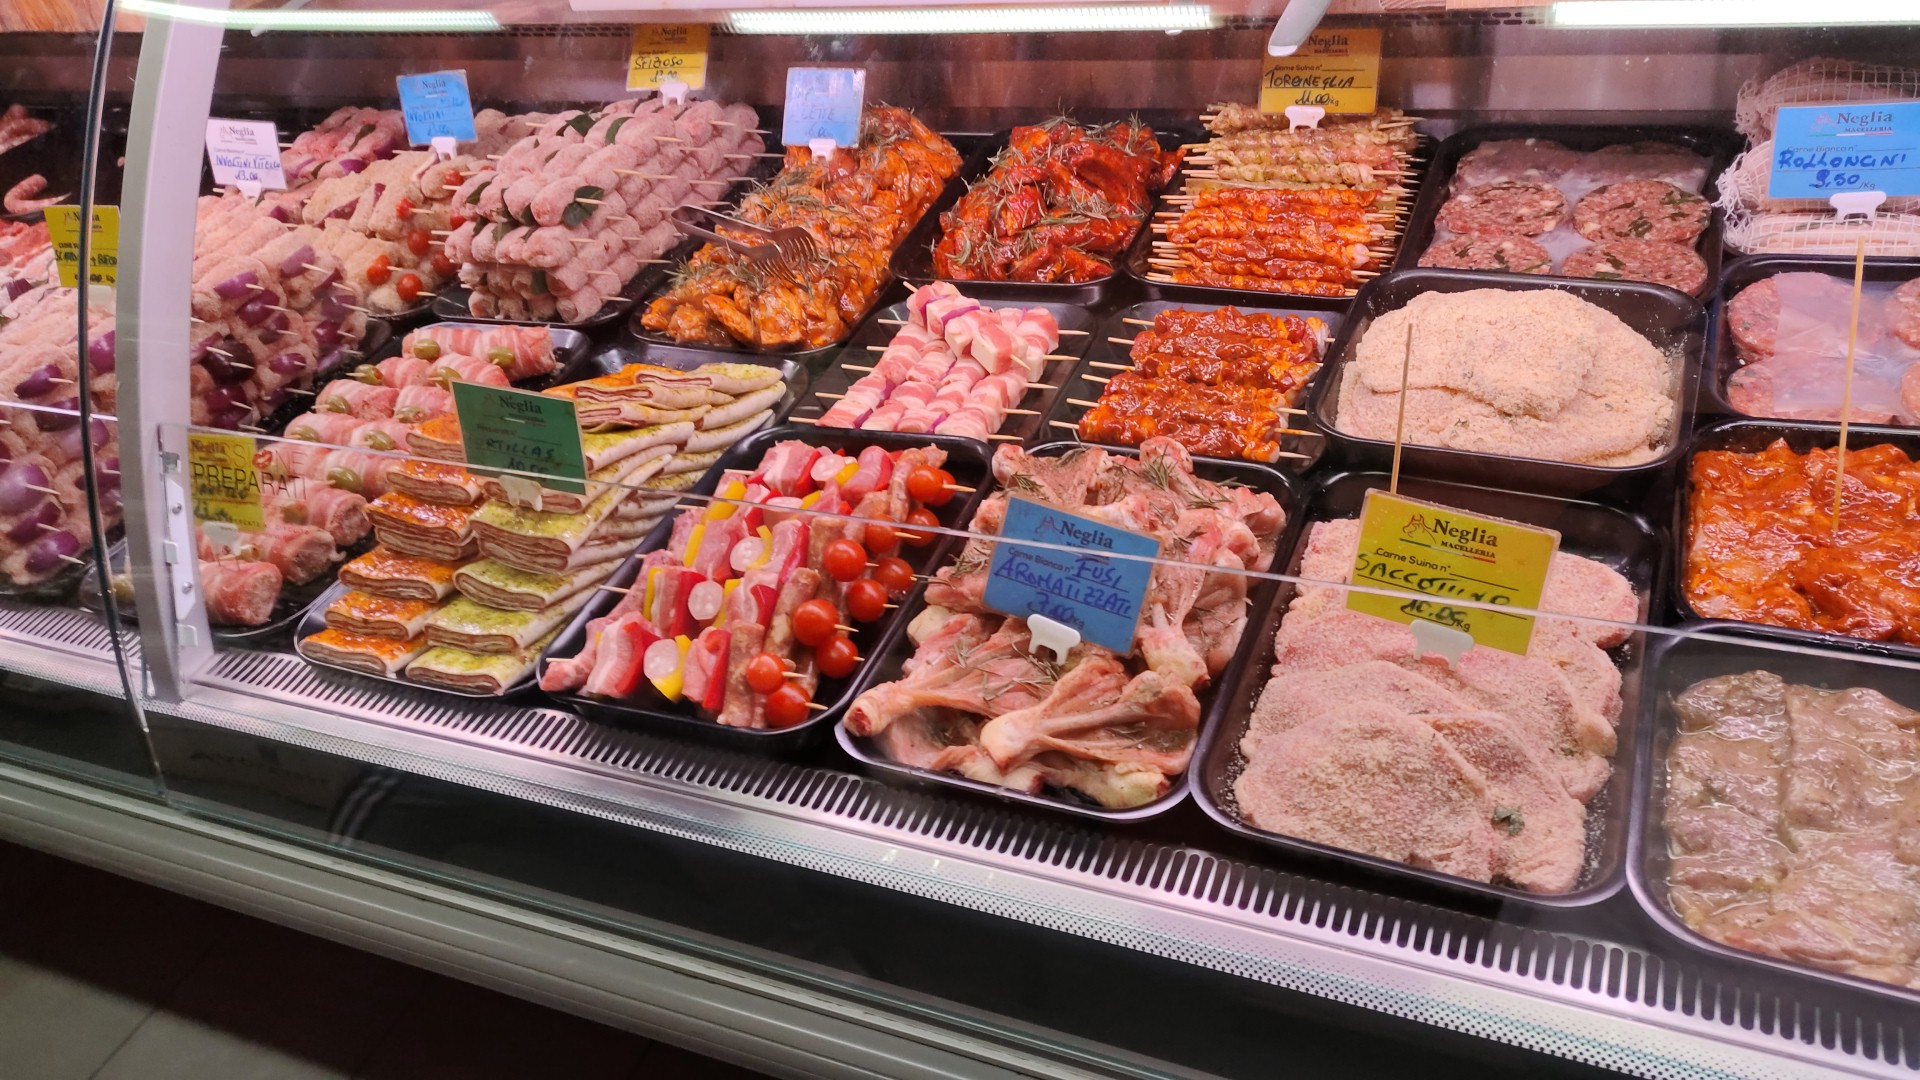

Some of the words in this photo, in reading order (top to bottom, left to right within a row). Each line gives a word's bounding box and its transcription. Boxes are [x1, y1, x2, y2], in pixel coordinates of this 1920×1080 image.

[1308, 35, 1349, 48] Neglia
[1837, 111, 1893, 126] Neglia
[229, 126, 256, 137] Neglia
[498, 394, 543, 415] Neglia
[190, 461, 307, 501] PREPARATI
[1060, 520, 1114, 549] Neglia
[1432, 518, 1499, 548] Neglia
[1007, 546, 1034, 562] Carne
[1034, 554, 1064, 573] Bianca
[1375, 547, 1408, 563] Carne
[1408, 556, 1439, 571] Suina
[1440, 540, 1496, 559] MACELLERIA
